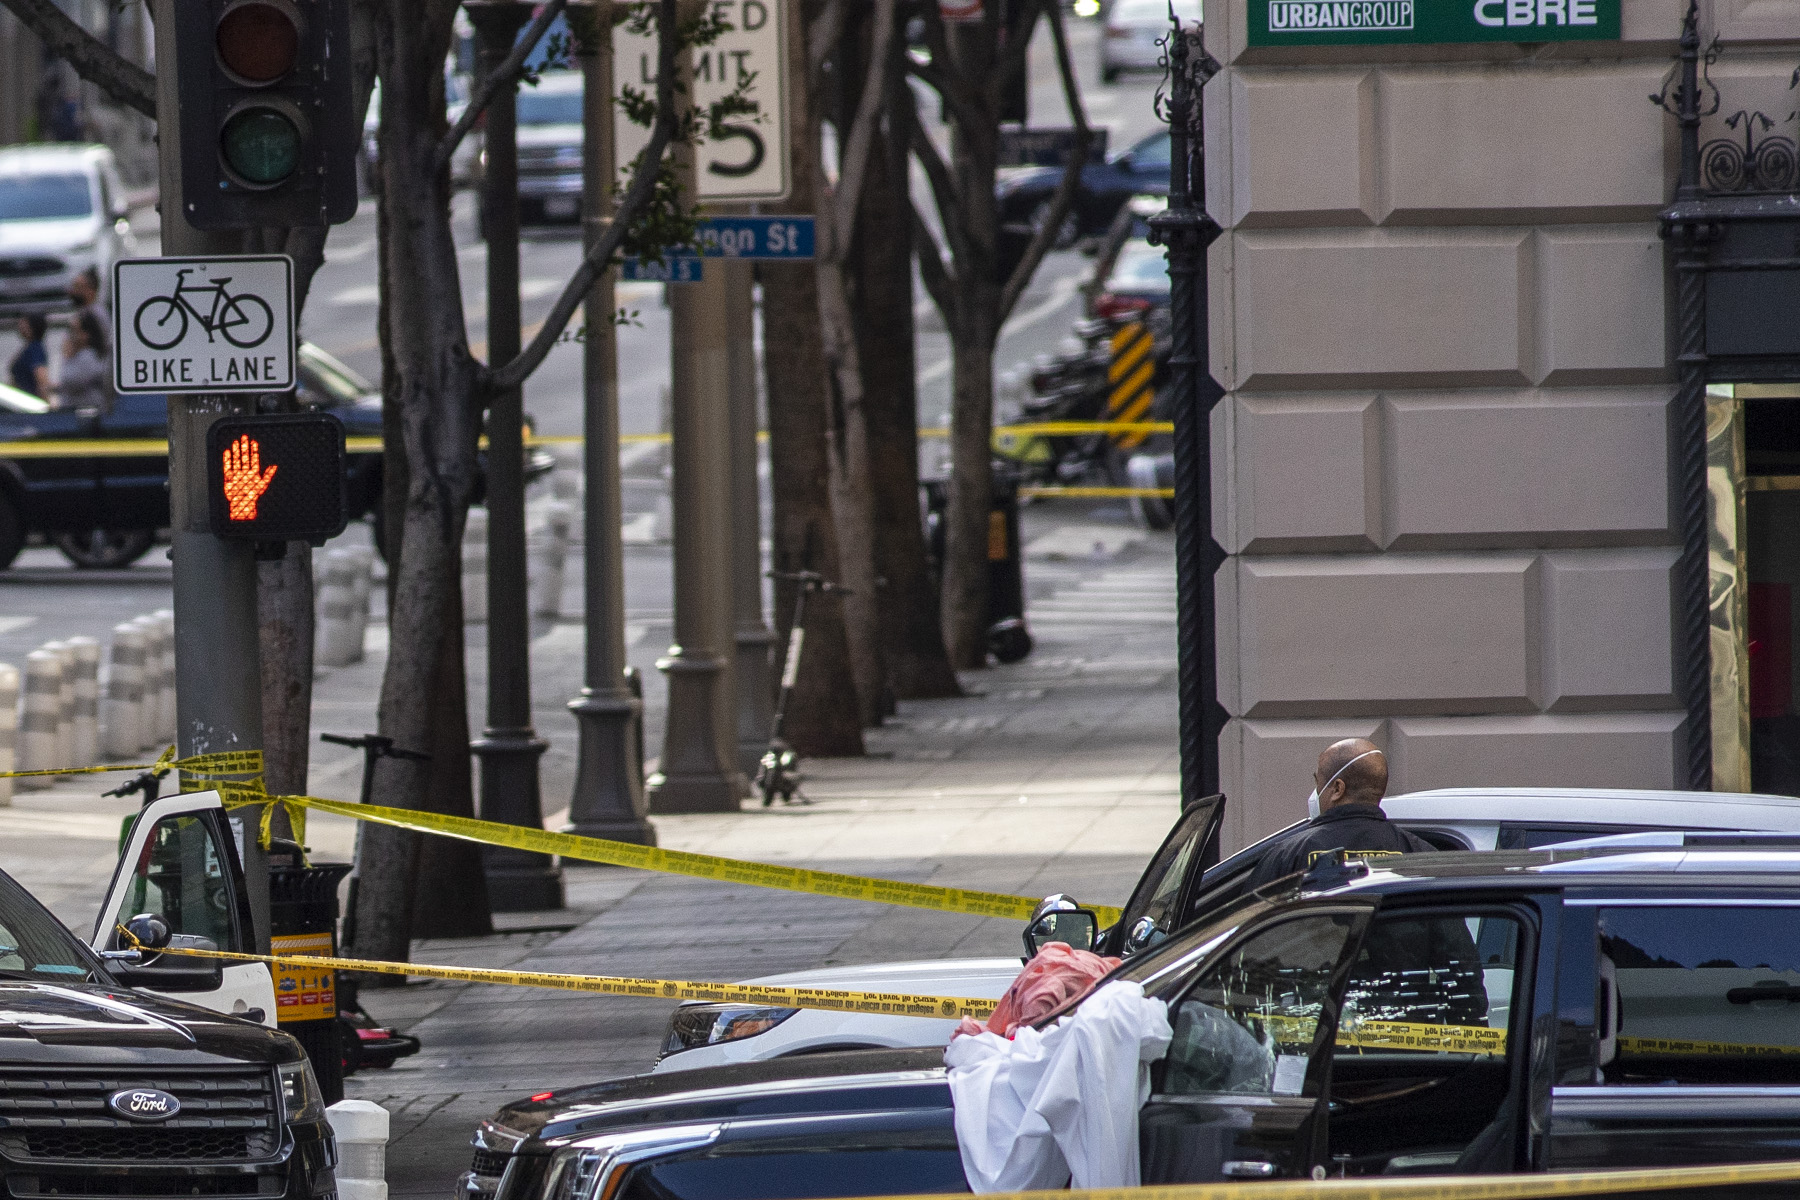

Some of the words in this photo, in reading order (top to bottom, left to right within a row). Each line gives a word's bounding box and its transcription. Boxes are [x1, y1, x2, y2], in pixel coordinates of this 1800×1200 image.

[1272, 2, 1411, 27] URBANGROUP
[1474, 0, 1598, 26] CBRE
[640, 51, 751, 84] LMIT
[767, 222, 798, 252] St
[134, 358, 193, 383] BIKE
[211, 356, 277, 382] LANE
[130, 1092, 168, 1112] Ford
